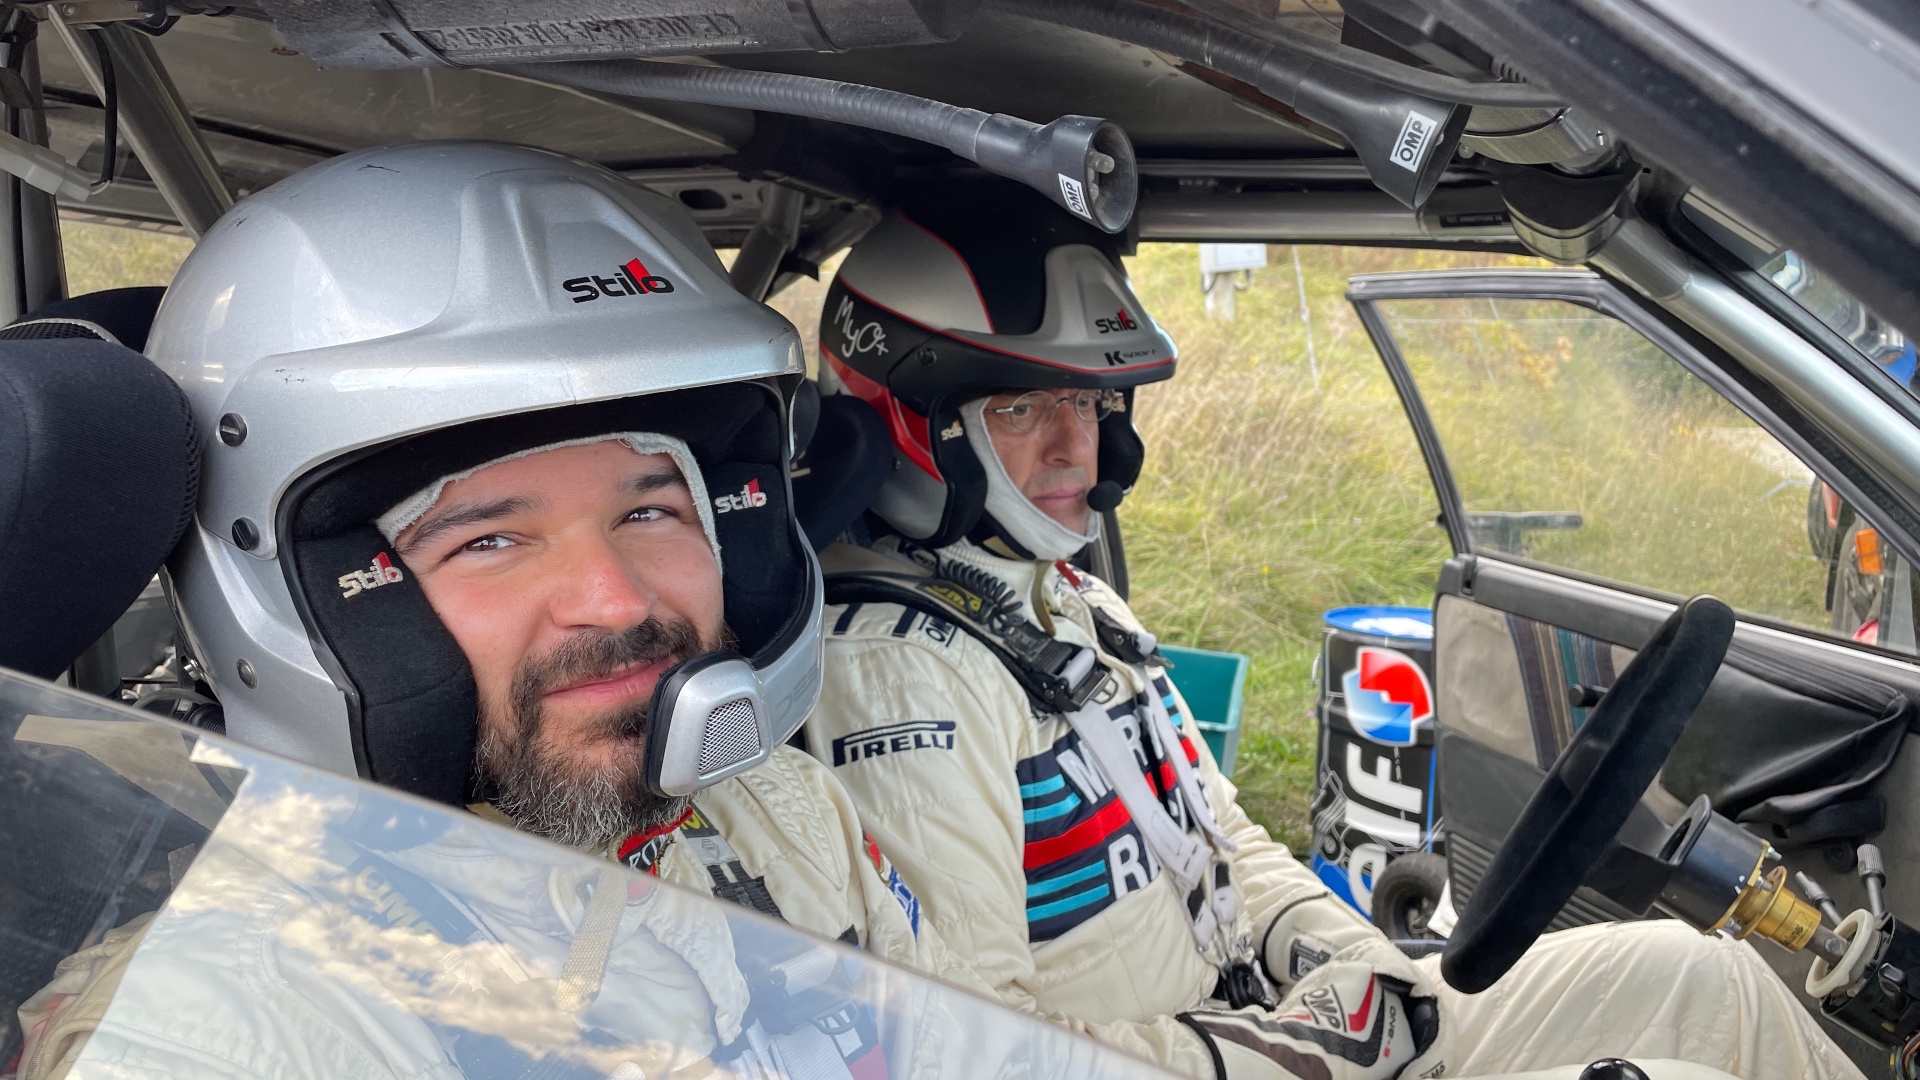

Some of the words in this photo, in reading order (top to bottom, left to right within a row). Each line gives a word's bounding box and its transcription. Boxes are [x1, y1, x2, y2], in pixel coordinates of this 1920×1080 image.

[1400, 120, 1424, 162] OMP
[1066, 181, 1084, 213] OMP
[832, 721, 956, 768] PIRELLI
[1311, 987, 1341, 1030] OMP
